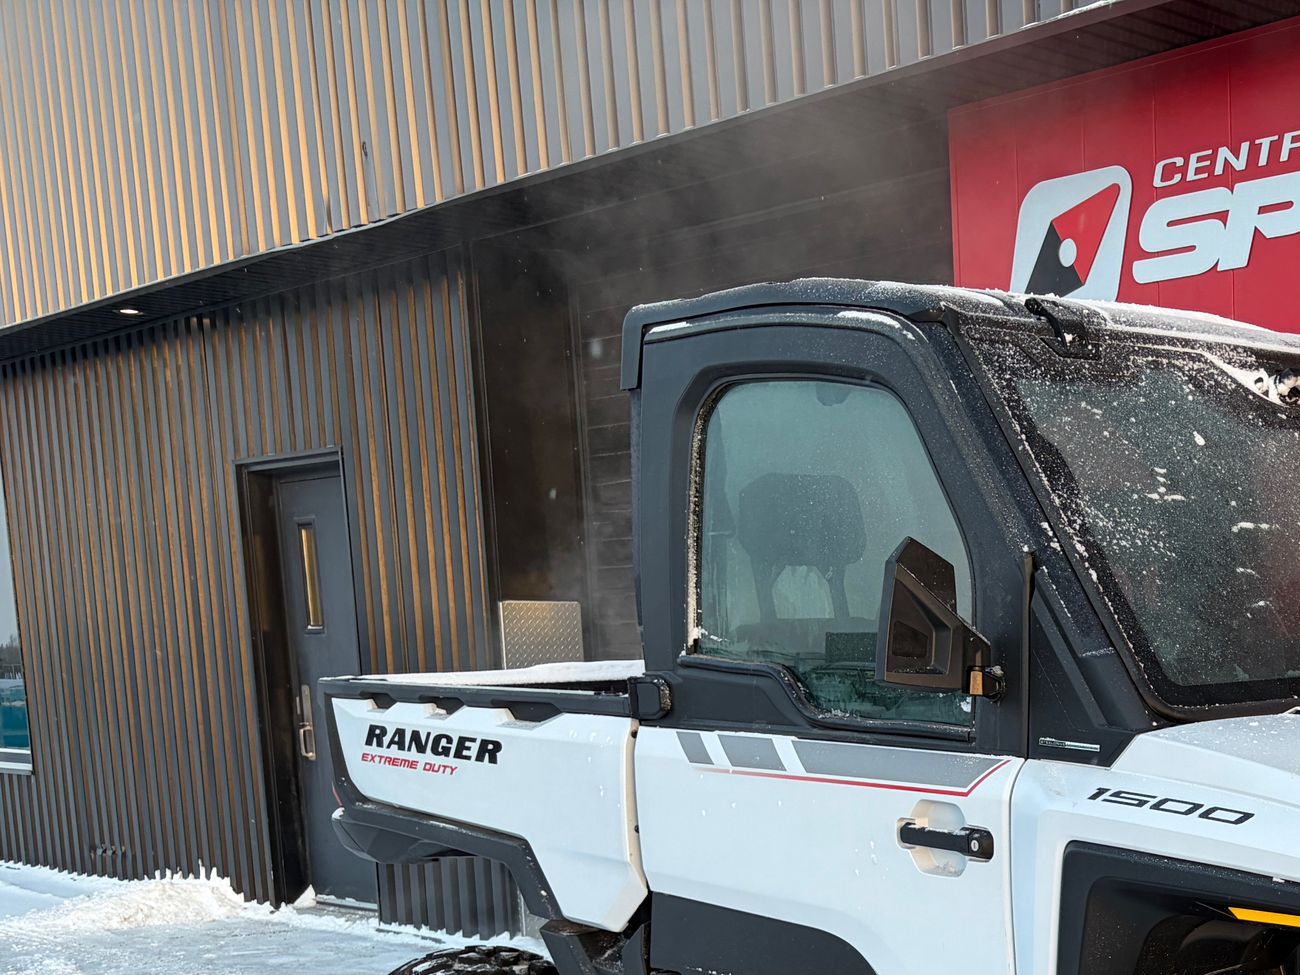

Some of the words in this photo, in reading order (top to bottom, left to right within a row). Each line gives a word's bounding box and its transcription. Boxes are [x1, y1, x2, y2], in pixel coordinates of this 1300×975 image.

[361, 752, 419, 770] EXTREME
[422, 761, 458, 775] DUTY
[365, 724, 503, 765] RANGER
[1087, 787, 1255, 825] 1500
